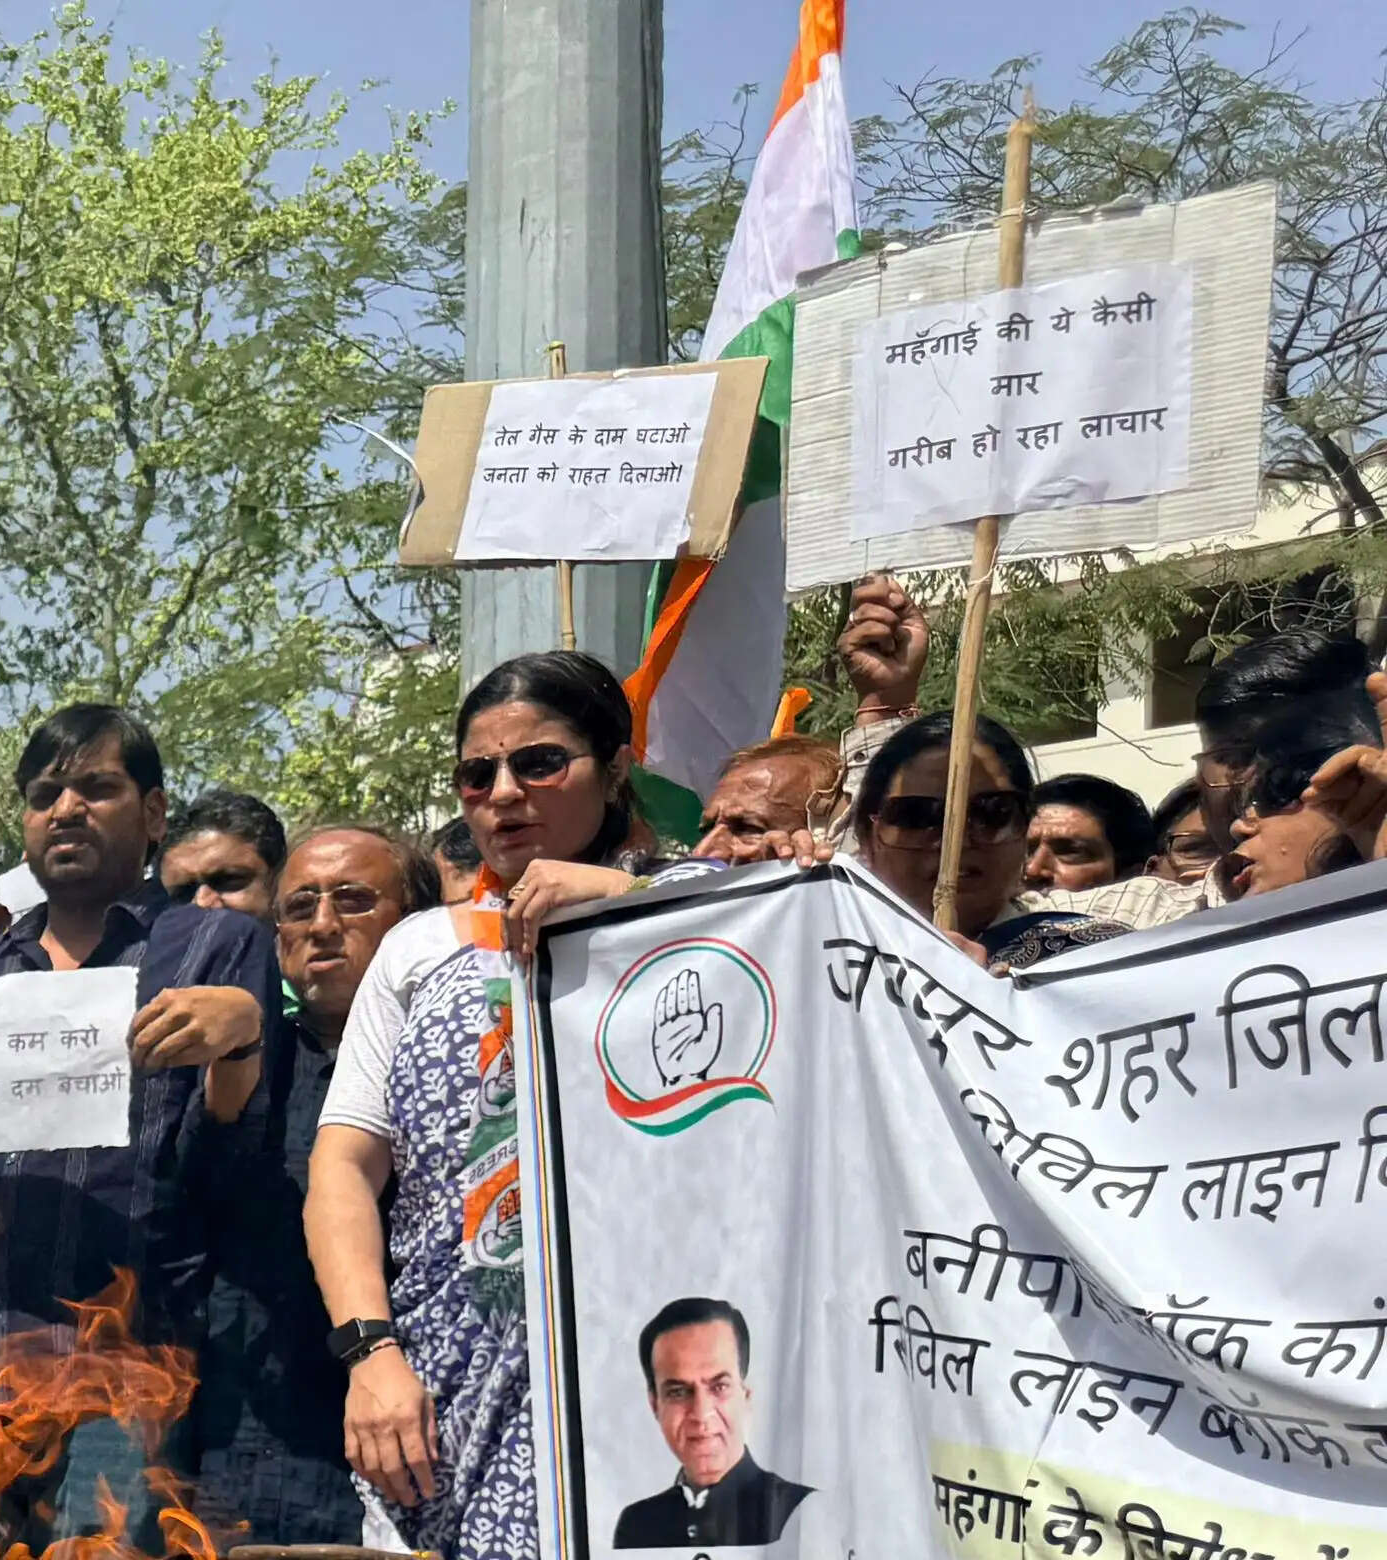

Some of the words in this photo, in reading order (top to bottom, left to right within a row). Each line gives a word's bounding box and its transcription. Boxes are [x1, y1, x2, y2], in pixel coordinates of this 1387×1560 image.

[886, 320, 981, 366] महँगाई
[996, 313, 1034, 343] की
[1051, 307, 1076, 335] ये
[1091, 292, 1157, 327] कैसी
[990, 371, 1044, 398] मार
[494, 426, 522, 447] तेल
[529, 423, 561, 446] गैस
[568, 424, 588, 446] के
[595, 427, 628, 446] दाम
[635, 422, 691, 444] घटाओ
[888, 437, 957, 471] गरीब
[972, 424, 1004, 459] हो
[1016, 421, 1063, 452] रहा
[1079, 406, 1169, 441] लाचार
[483, 466, 529, 484] जनता
[537, 461, 559, 482] को
[569, 466, 611, 487] राहत
[7, 1030, 48, 1052] कम
[59, 1024, 99, 1049] करो
[1045, 1013, 1197, 1124] शहर
[1216, 963, 1387, 1090] जिल
[11, 1078, 44, 1099] दम
[1181, 1141, 1342, 1224] लाइन
[1010, 1349, 1187, 1436] लाइन
[1043, 1486, 1105, 1556] के
